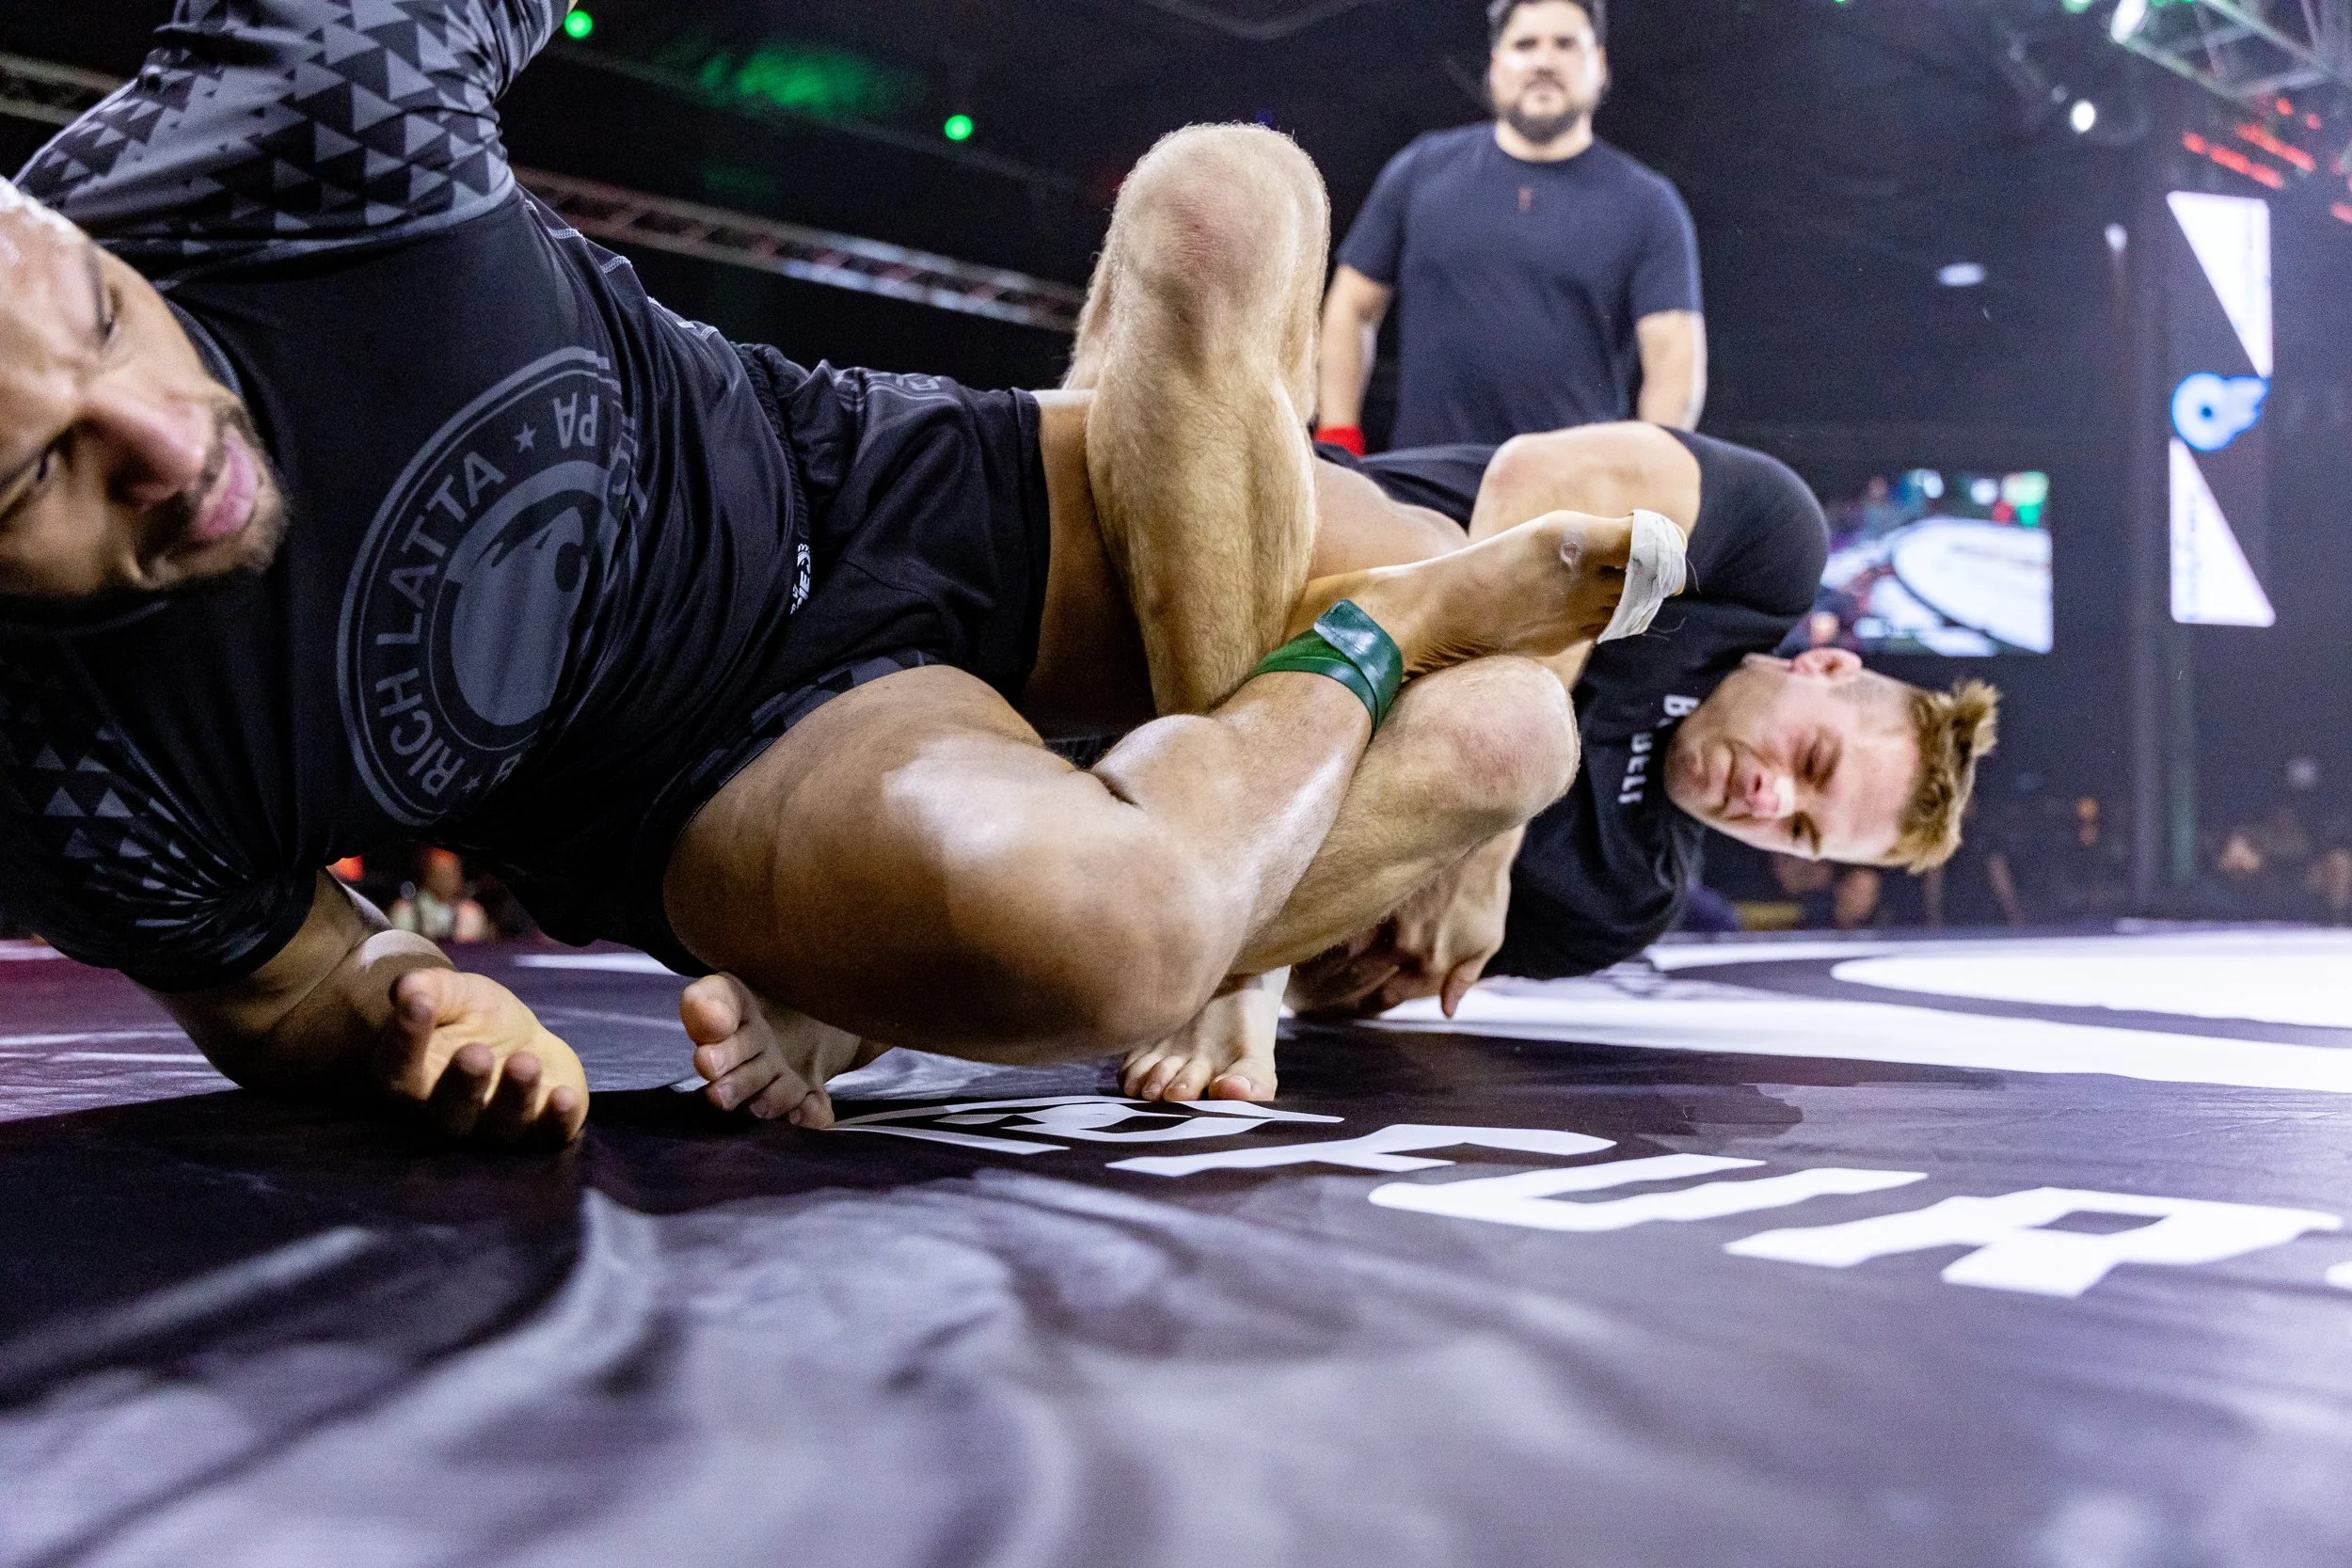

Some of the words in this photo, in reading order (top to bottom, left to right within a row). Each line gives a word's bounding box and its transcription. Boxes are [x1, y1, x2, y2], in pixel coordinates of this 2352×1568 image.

[552, 391, 599, 448] PA
[376, 451, 506, 645] LATTA
[376, 667, 466, 797] RICH
[1106, 1123, 2352, 1298] FUR
